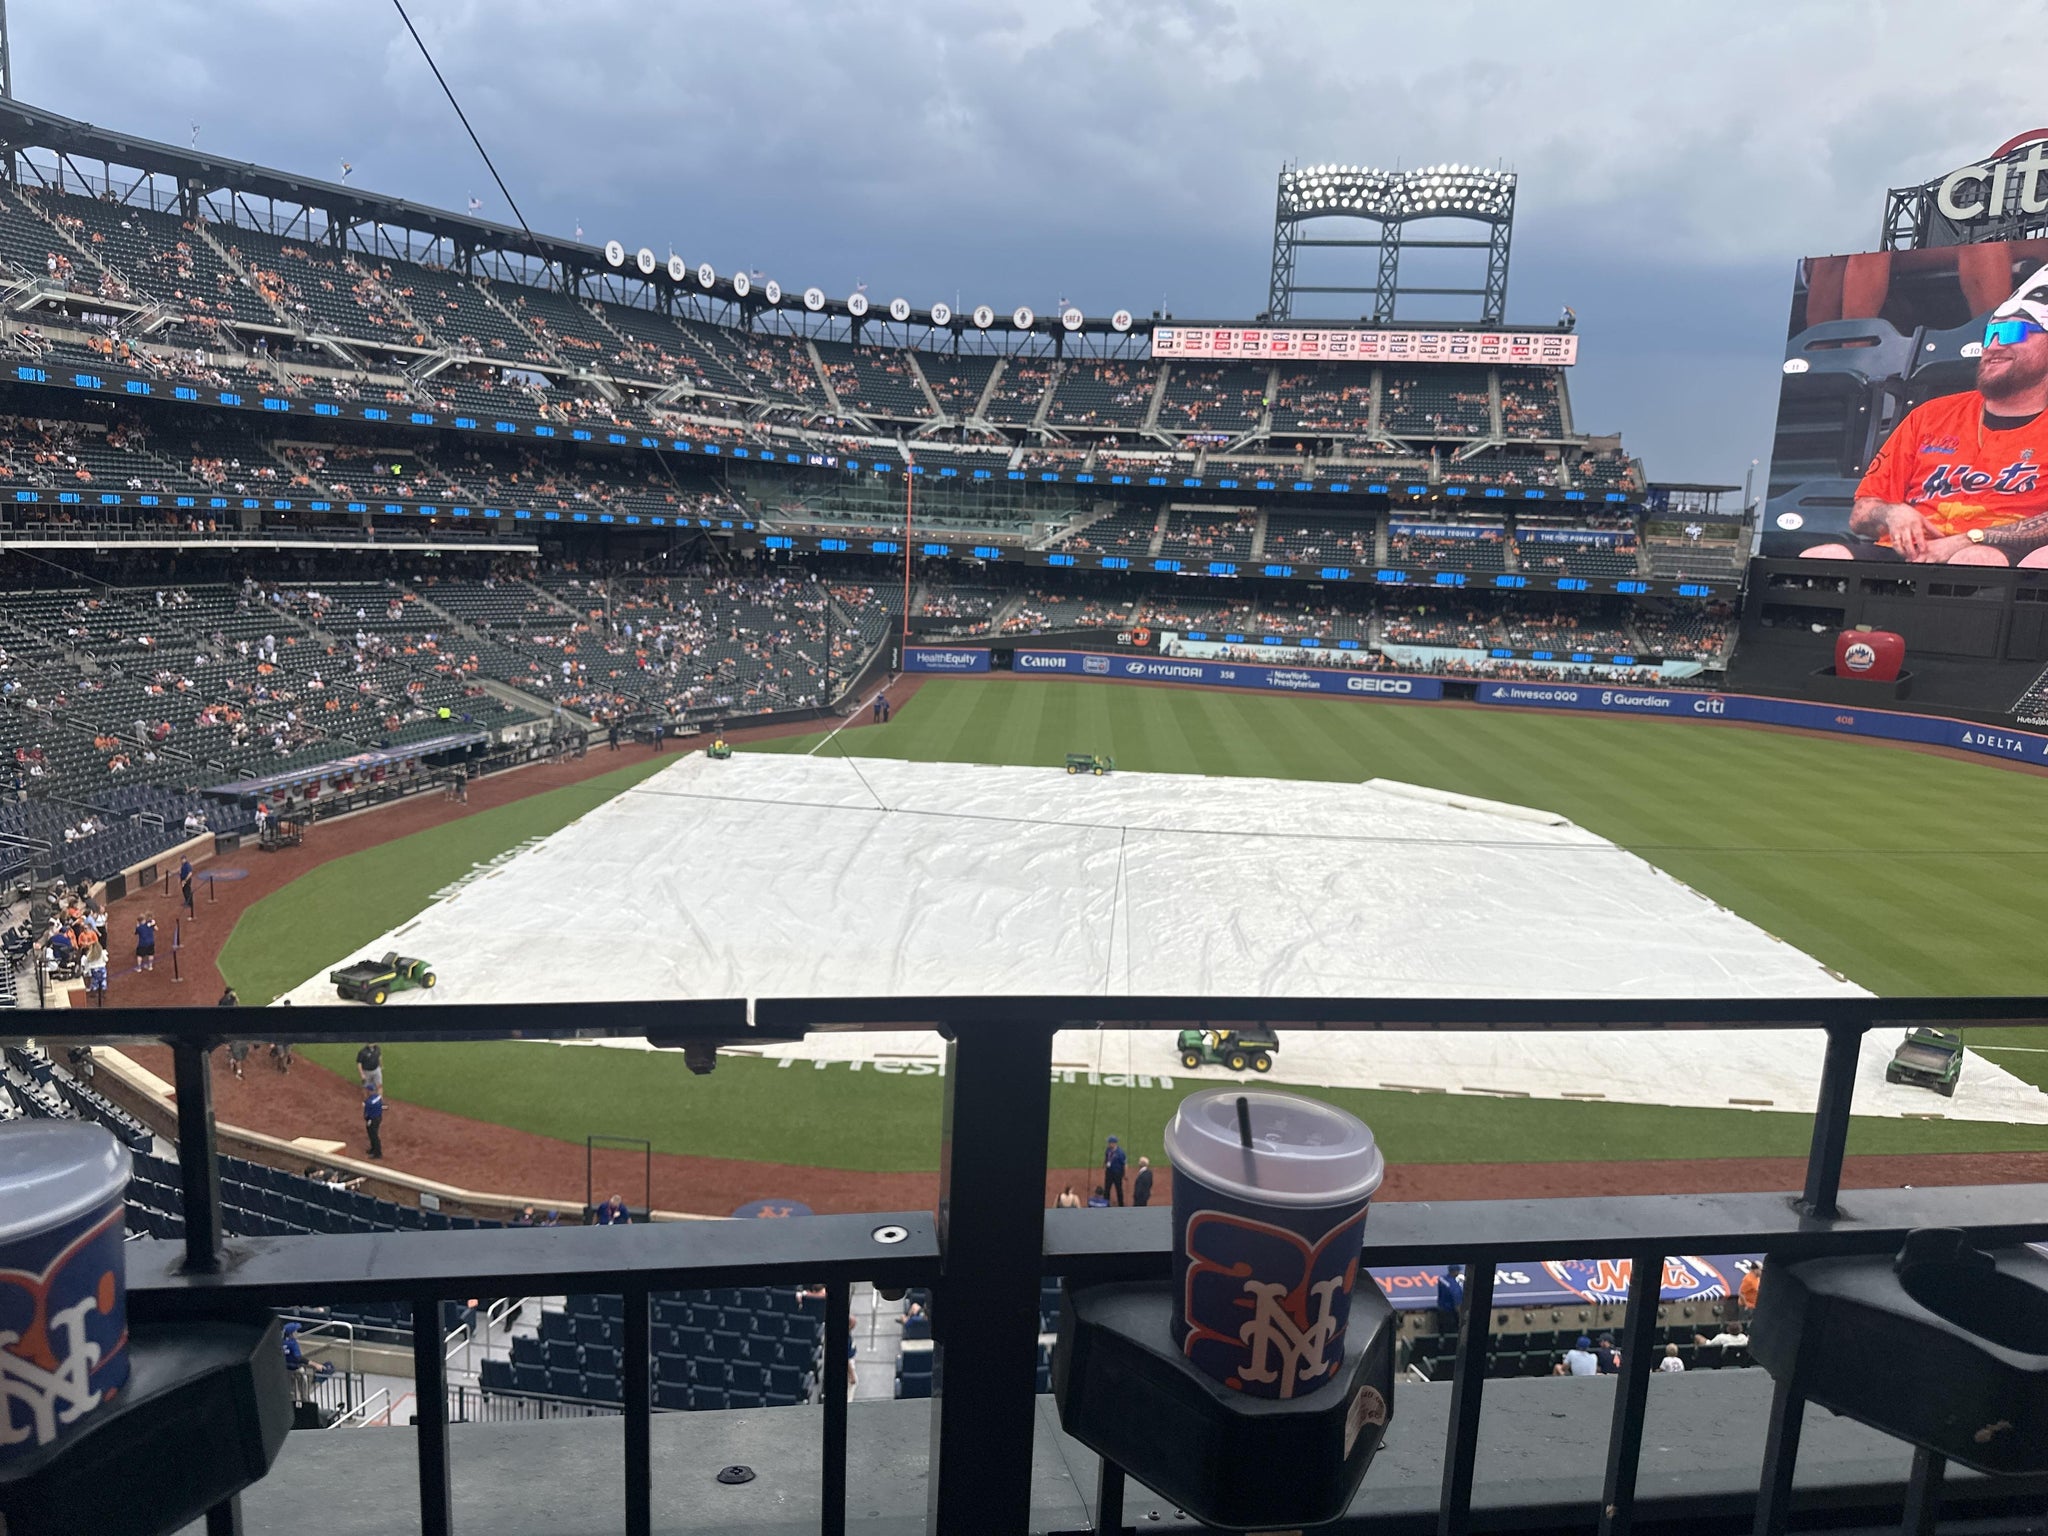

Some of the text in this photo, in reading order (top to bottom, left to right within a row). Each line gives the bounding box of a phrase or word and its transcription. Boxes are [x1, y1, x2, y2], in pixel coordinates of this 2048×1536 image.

[612, 247, 618, 259] 5
[642, 254, 651, 267] 18
[672, 263, 681, 274] 16
[701, 270, 711, 281] 24
[737, 279, 746, 290] 17
[810, 294, 820, 305] 31
[853, 299, 863, 310] 41
[895, 304, 905, 315] 14
[935, 309, 946, 320] 37
[1115, 315, 1128, 326] 42
[917, 653, 976, 666] HealthEquity
[1020, 655, 1066, 667] Canon
[1148, 664, 1203, 678] HYUNDAI
[1274, 671, 1310, 680] NewYork-
[1273, 678, 1320, 689] Presbyterian
[1347, 677, 1412, 694] GEICO
[1510, 688, 1577, 702] Invesco QQQ
[1614, 693, 1670, 708] Guardian
[1694, 698, 1725, 714] citi
[1976, 733, 2023, 753] DELTA
[1587, 1257, 1700, 1293] Mts
[1375, 1271, 1439, 1293] york
